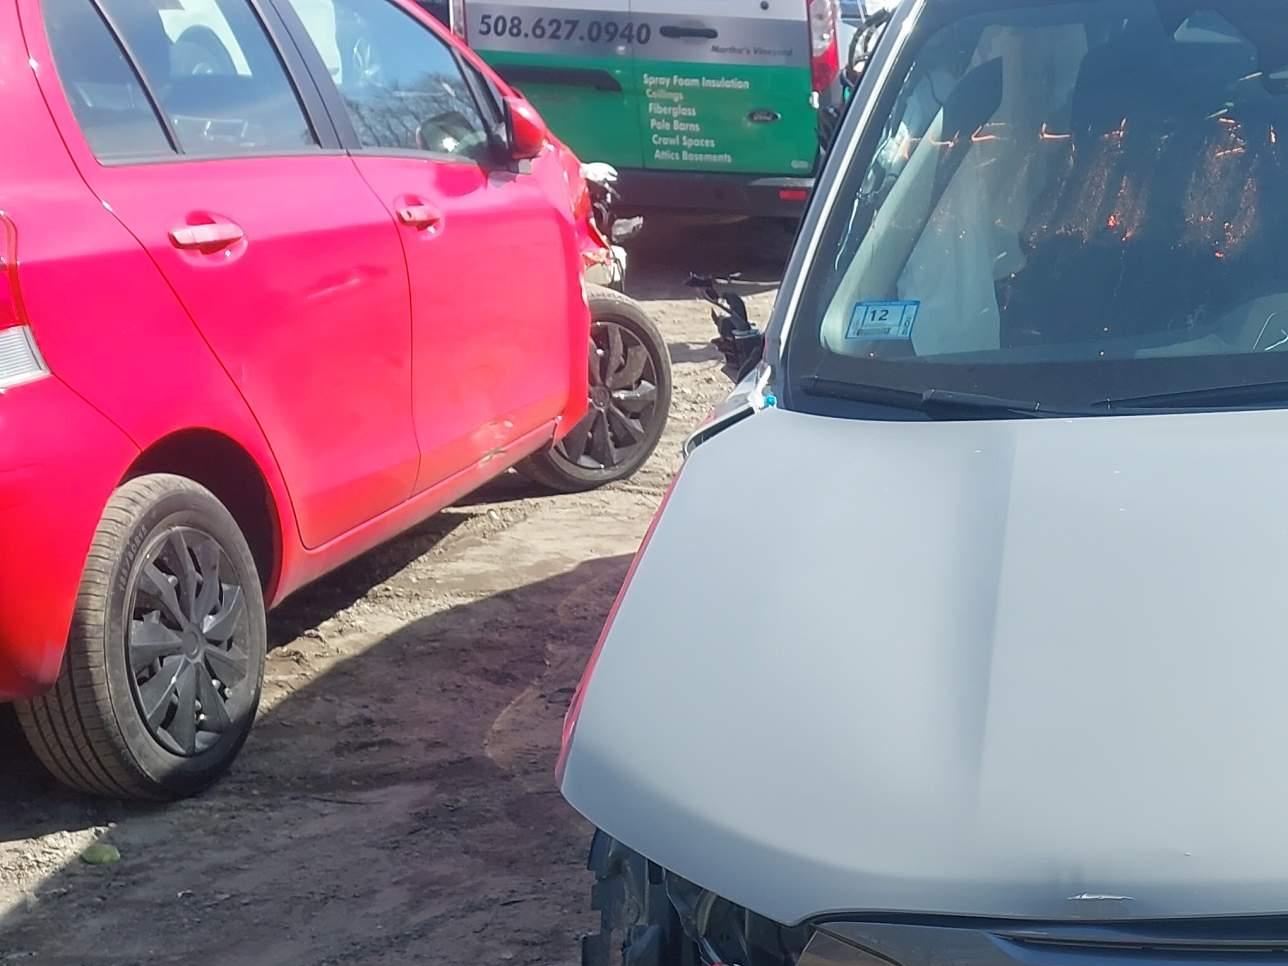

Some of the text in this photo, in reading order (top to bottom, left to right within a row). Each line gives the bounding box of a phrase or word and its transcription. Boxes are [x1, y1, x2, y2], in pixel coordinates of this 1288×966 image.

[478, 14, 651, 45] 508.627.0940
[643, 73, 750, 89] Spray Foam Insulation
[648, 102, 697, 117] Fiberglass
[650, 118, 701, 132] Pole Barns
[651, 133, 715, 148] Crawl Spaces
[654, 149, 732, 163] Attics Basements
[870, 309, 889, 321] 12
